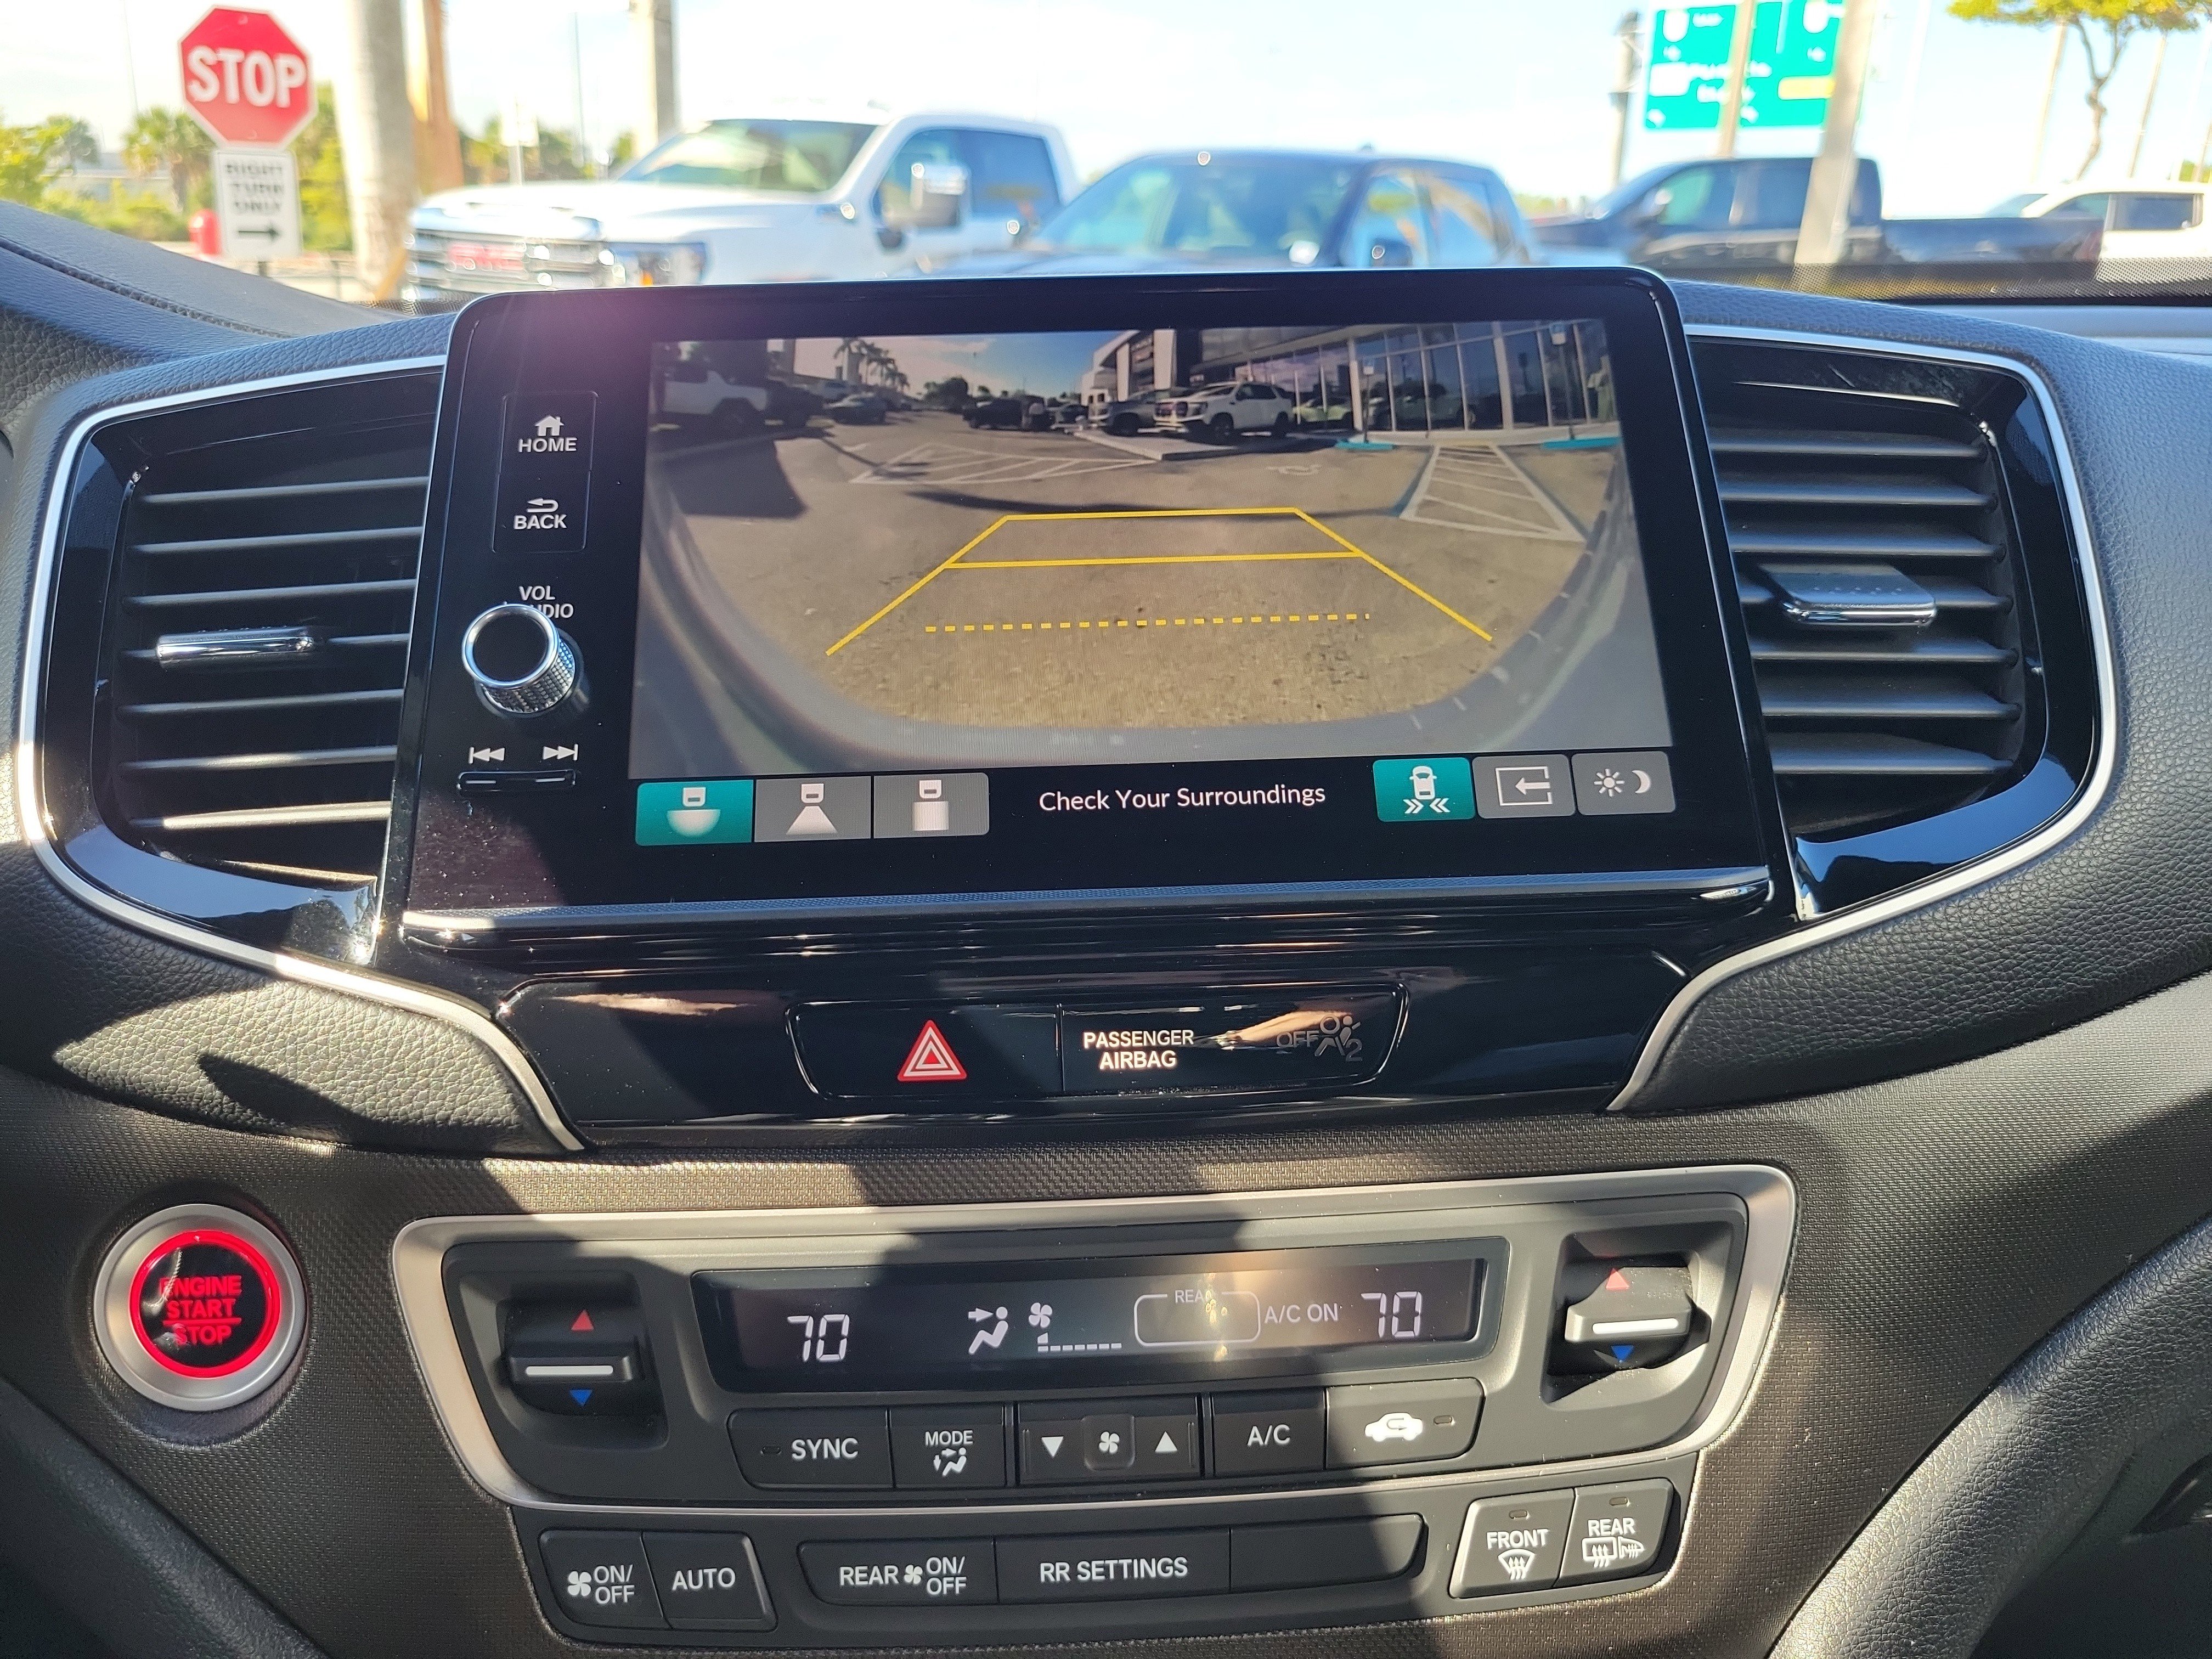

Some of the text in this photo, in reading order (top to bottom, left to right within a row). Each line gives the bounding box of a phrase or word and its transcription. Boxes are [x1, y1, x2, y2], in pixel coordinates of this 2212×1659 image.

[188, 45, 306, 108] STOP
[518, 438, 577, 453] HOME
[514, 514, 567, 529] BACK
[519, 585, 556, 601] VOL
[1039, 784, 1326, 811] Check Your Surroundings
[1083, 1029, 1194, 1049] PASSENGER
[1276, 1030, 1319, 1047] OFF
[1099, 1051, 1177, 1070] AIRBAG
[159, 1274, 242, 1296] ENGINE
[1175, 1289, 1213, 1304] REA
[166, 1299, 236, 1319] START
[1264, 1302, 1339, 1324] A/C ON
[1361, 1291, 1423, 1338] 70
[173, 1323, 233, 1346] STOP
[787, 1313, 850, 1362] 70
[925, 1430, 974, 1447] MODE
[1246, 1424, 1291, 1447] A/C
[791, 1437, 859, 1460] SYNC
[1588, 1517, 1635, 1537] REAR
[1486, 1528, 1550, 1550] FRONT
[594, 1564, 634, 1584] ON/
[672, 1567, 736, 1591] AUTO
[839, 1556, 966, 1586] REAR ON/
[1039, 1556, 1189, 1583] RR SETTINGS
[595, 1584, 635, 1605] OFF
[927, 1576, 967, 1596] OFF
